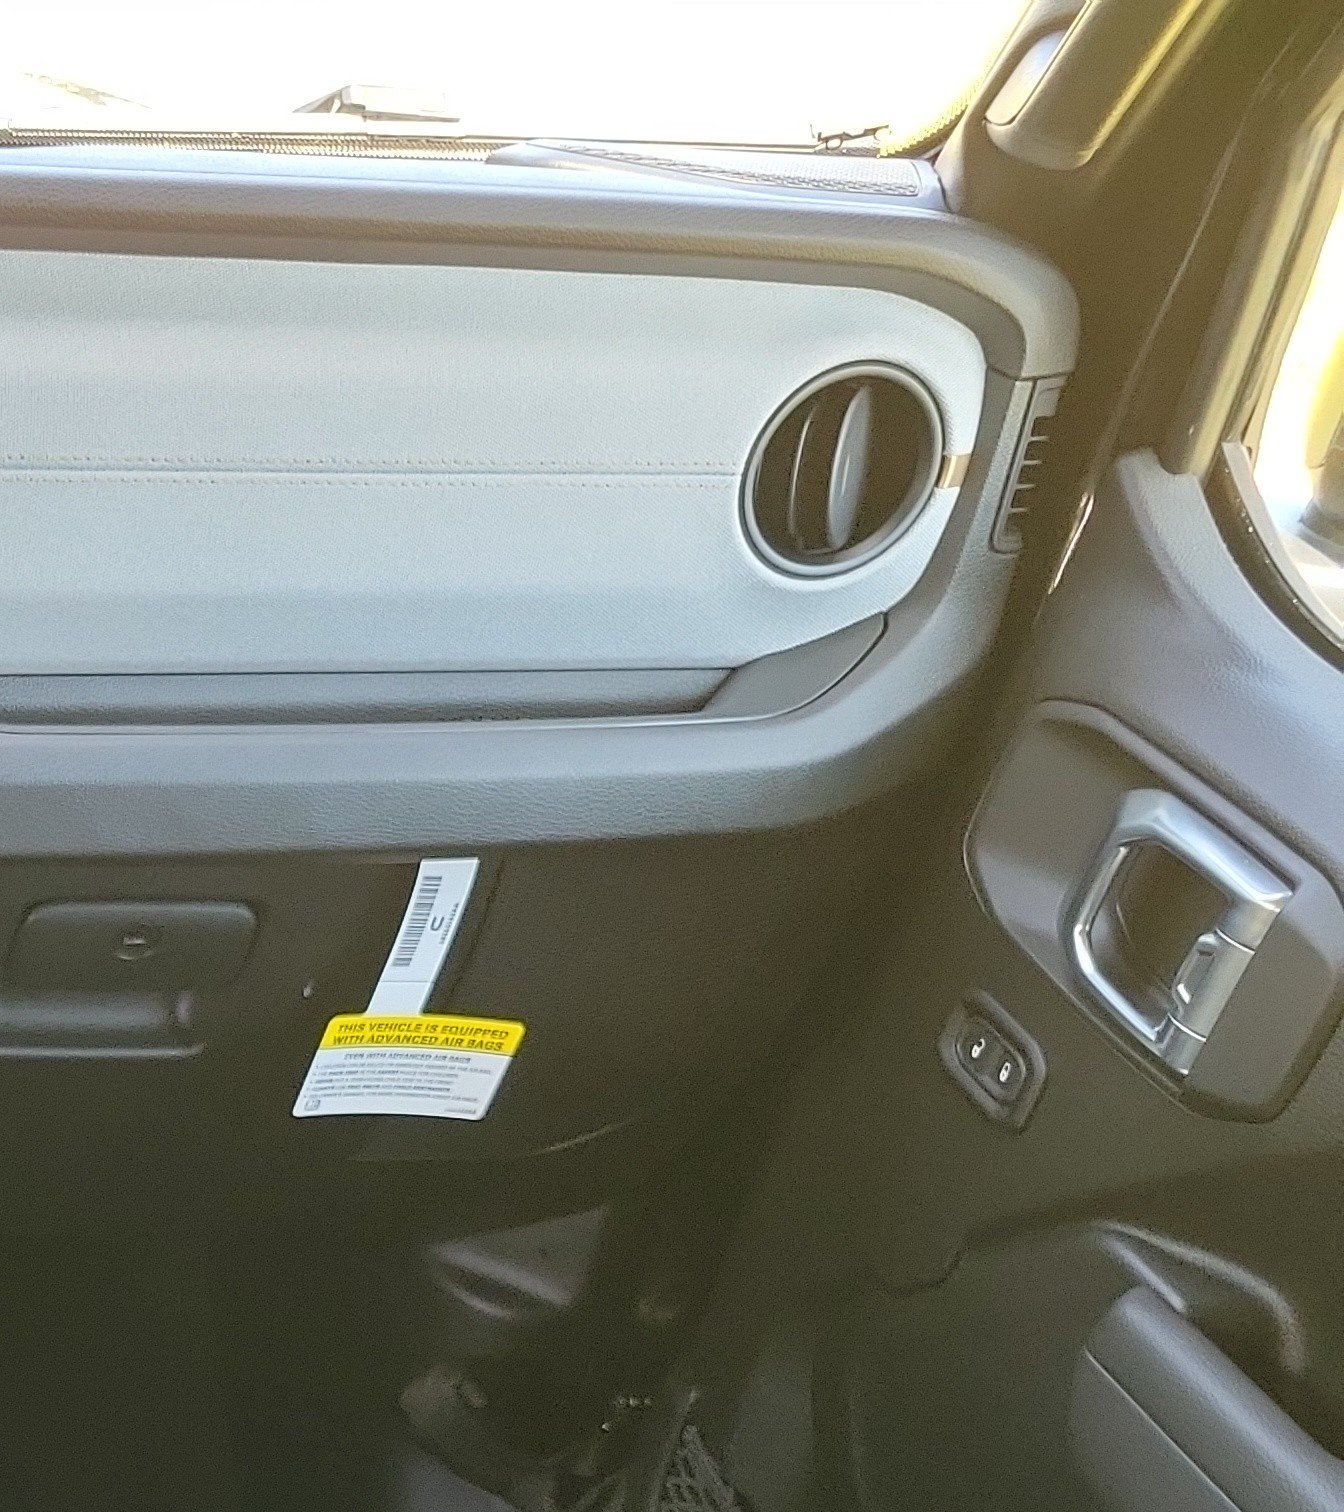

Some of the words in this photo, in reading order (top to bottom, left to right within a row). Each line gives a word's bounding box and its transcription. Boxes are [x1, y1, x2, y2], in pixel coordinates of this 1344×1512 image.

[338, 1023, 365, 1034] THIS
[368, 1023, 420, 1034] VEHICLE
[425, 1023, 439, 1034] IS
[442, 1025, 510, 1040] EQUIPPED
[332, 1035, 363, 1046] WITH
[365, 1035, 439, 1046] ADVANCED
[441, 1035, 464, 1046] AIR
[466, 1038, 505, 1051] BAGS
